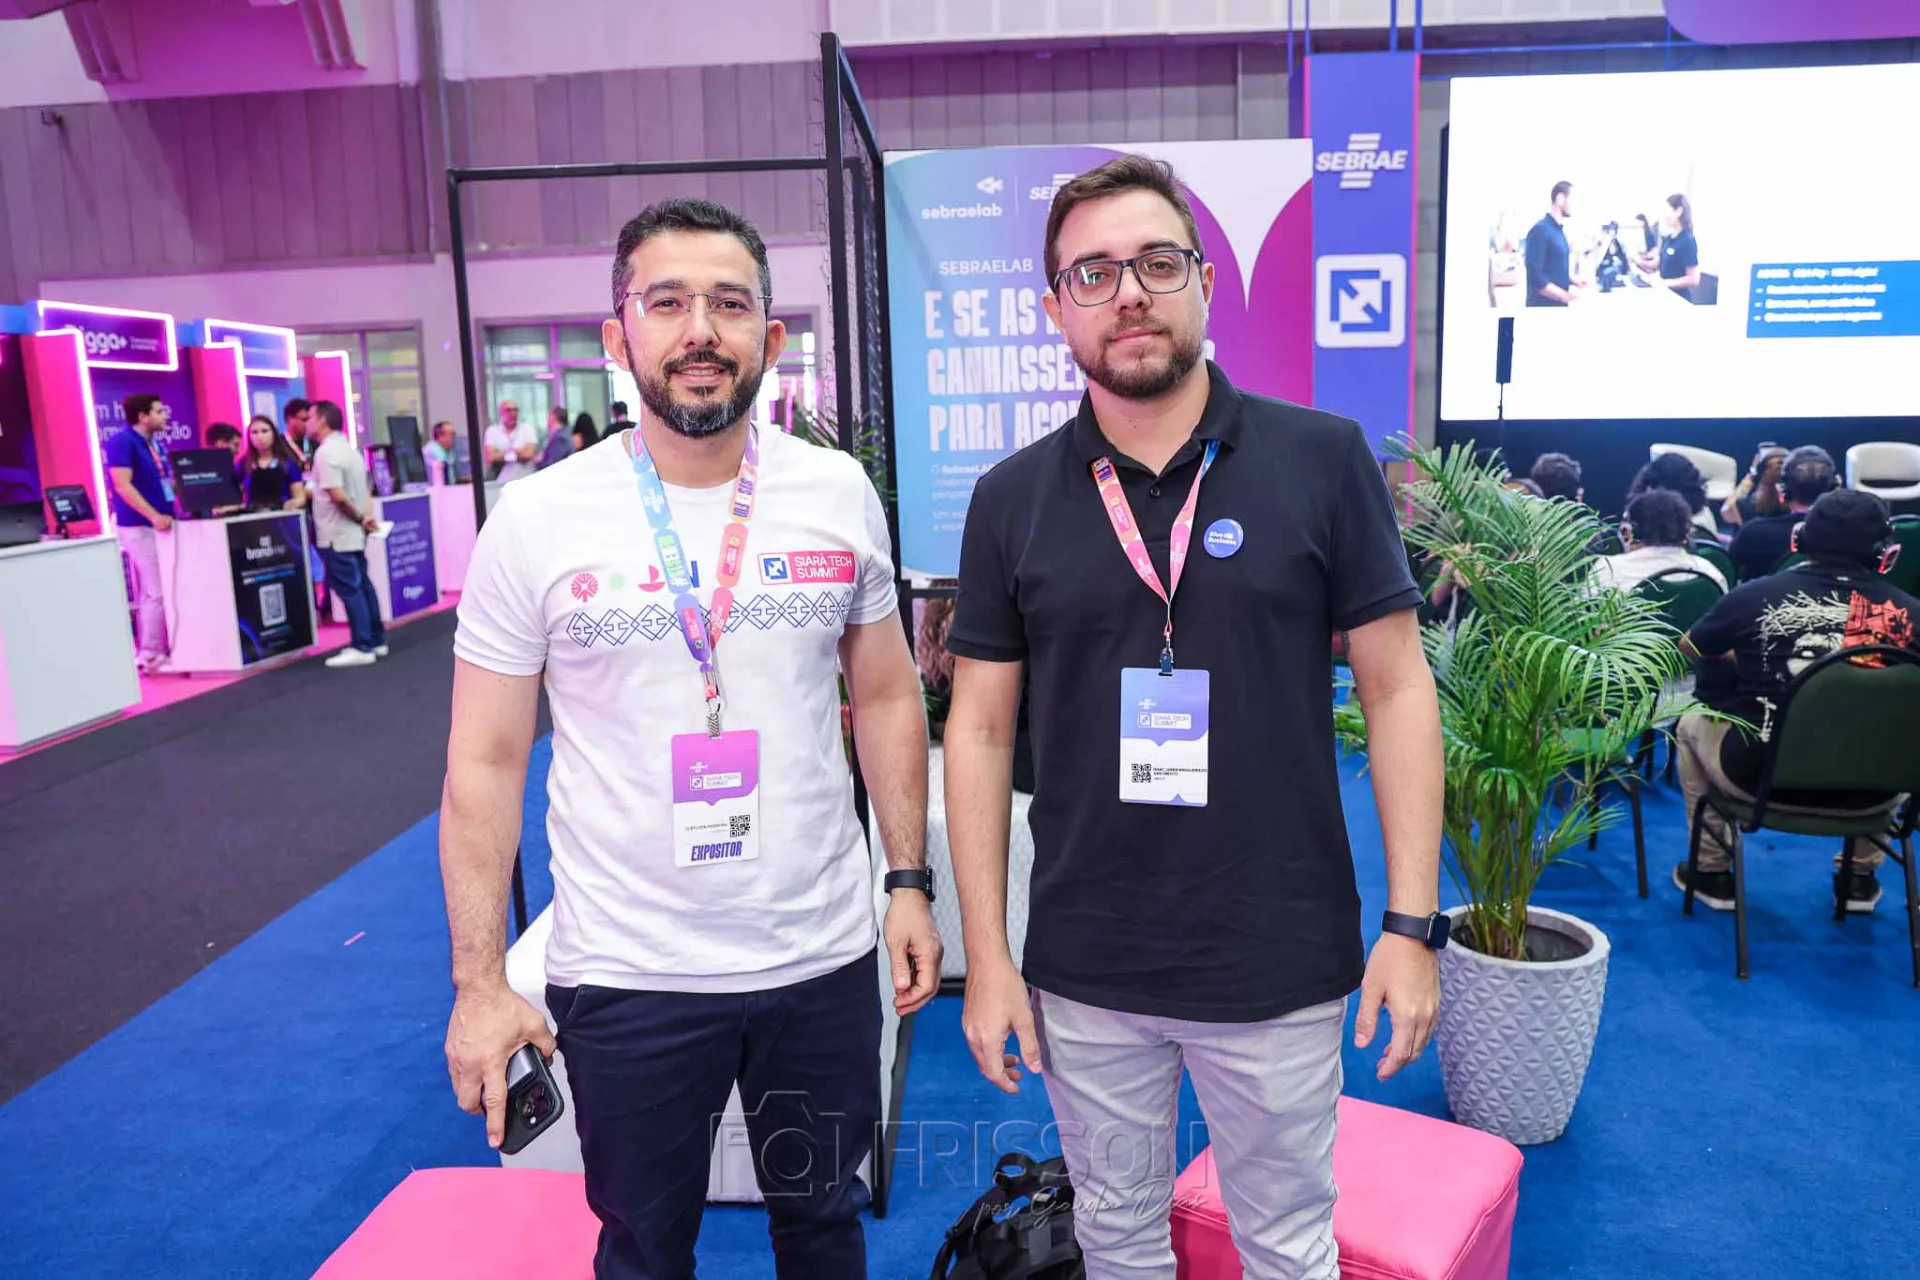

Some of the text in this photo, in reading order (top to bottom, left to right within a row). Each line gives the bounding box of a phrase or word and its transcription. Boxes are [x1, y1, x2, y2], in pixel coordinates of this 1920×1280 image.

[1316, 149, 1408, 172] SEBRAE
[921, 203, 1003, 220] sebraelab
[938, 259, 1034, 276] SEBRAELAB
[924, 290, 944, 338] E
[952, 288, 990, 337] SE
[1000, 287, 1037, 336] AS
[929, 402, 1004, 452] PARA
[828, 554, 853, 567] TECH
[796, 567, 839, 579] SUMMIT
[690, 841, 743, 861] EXPOSITOR
